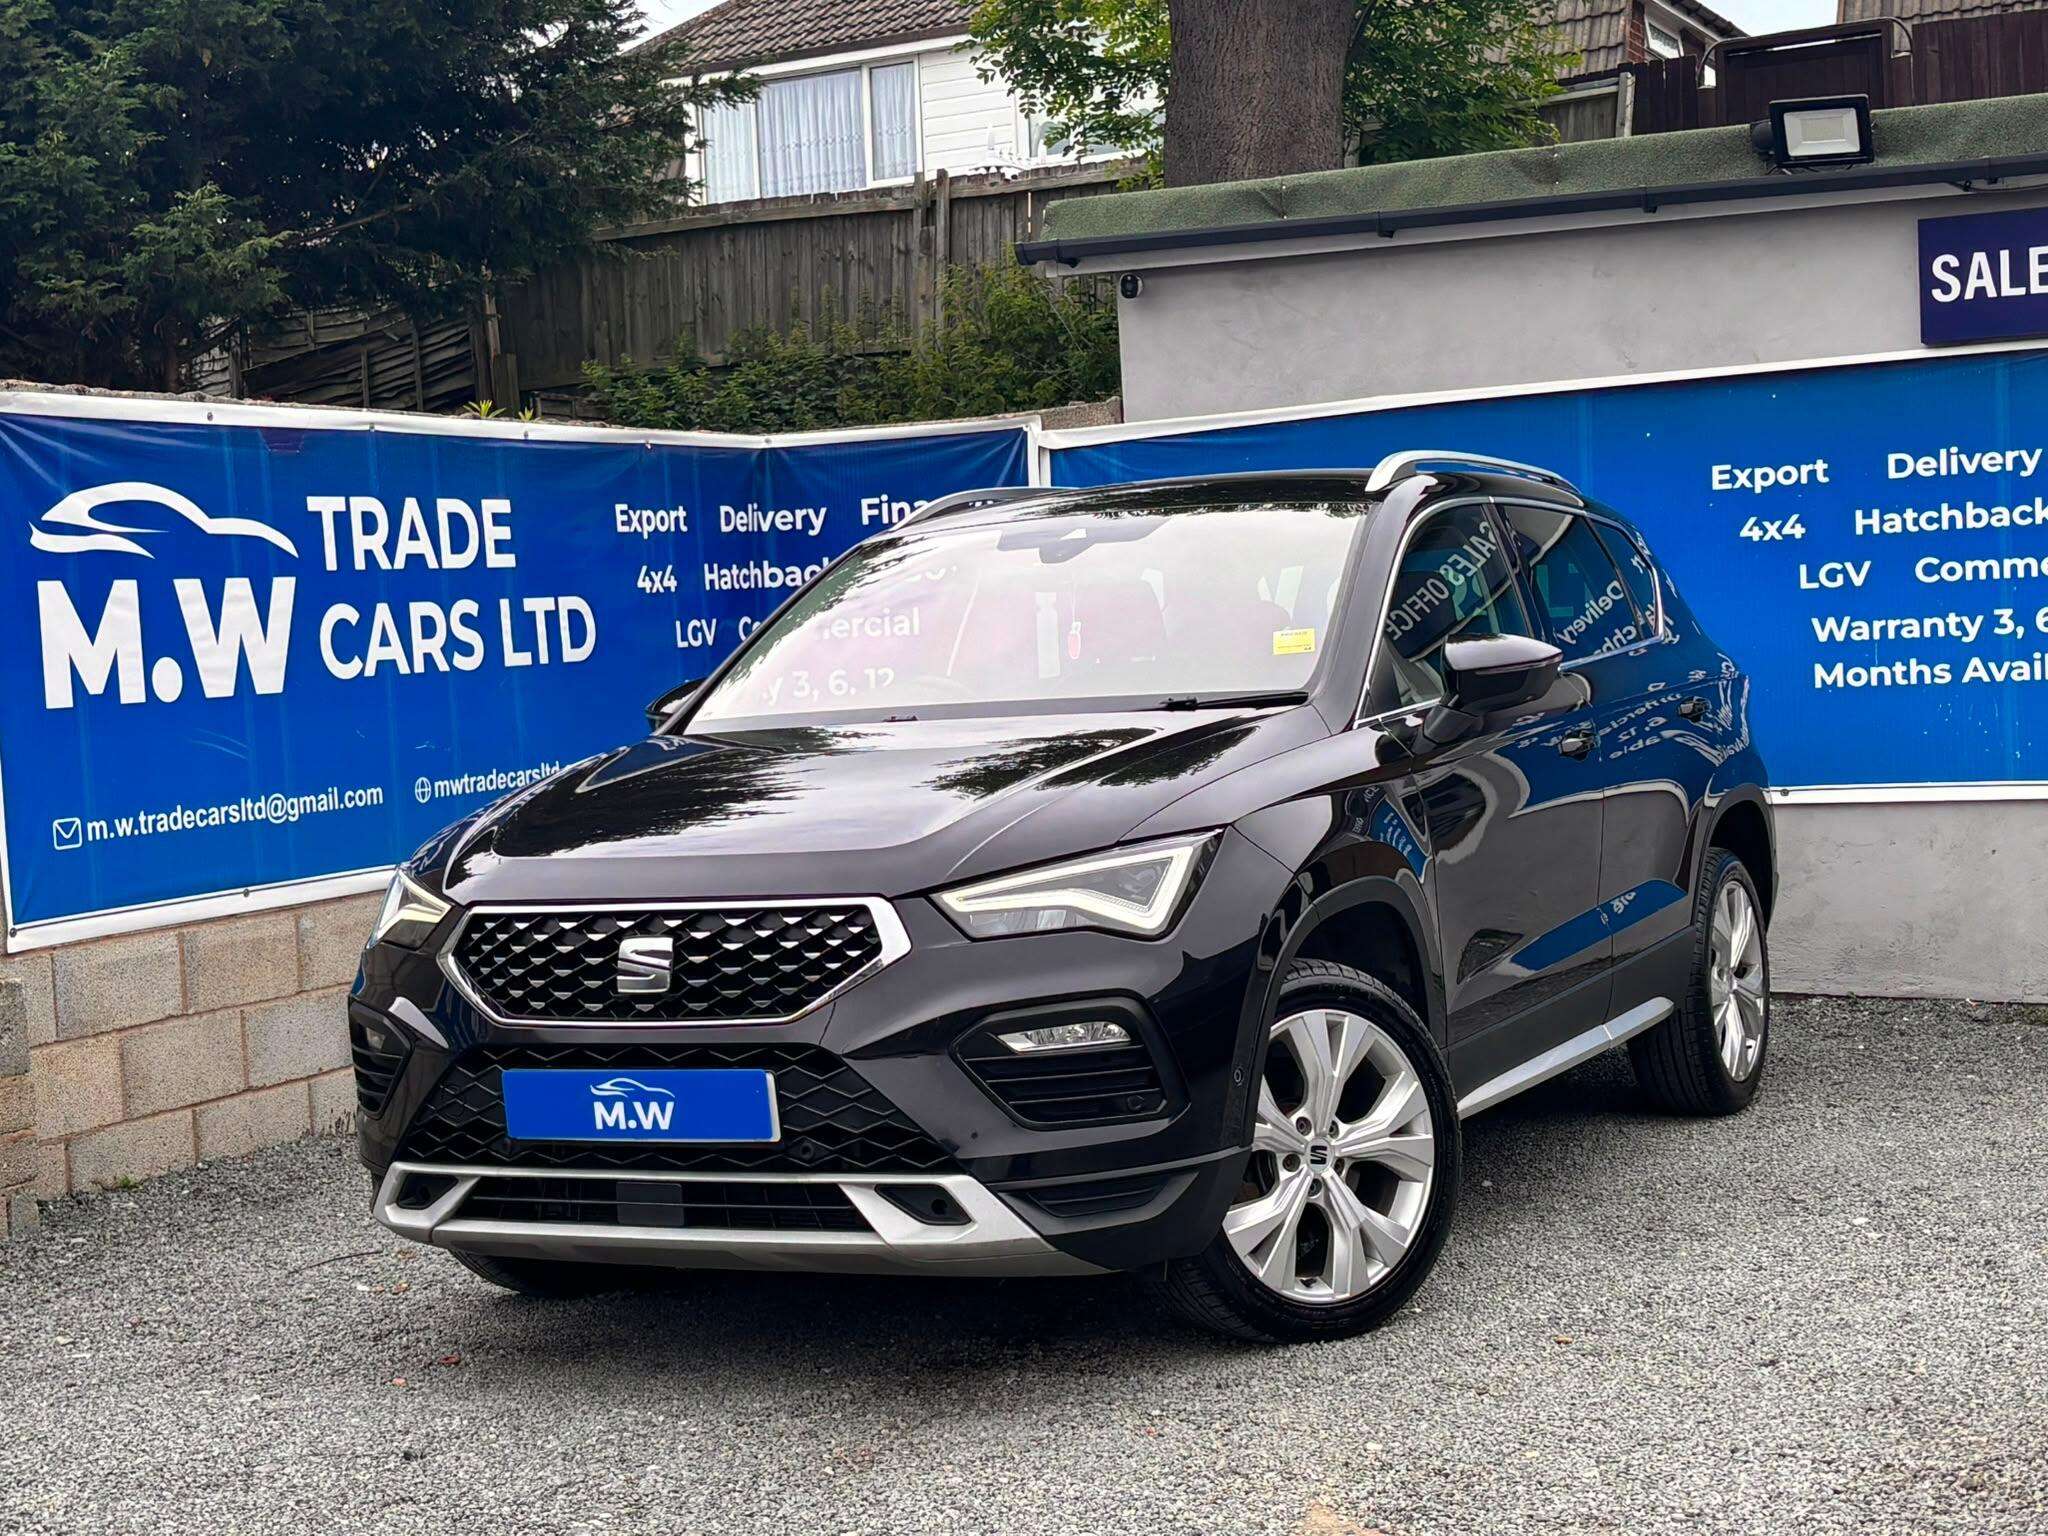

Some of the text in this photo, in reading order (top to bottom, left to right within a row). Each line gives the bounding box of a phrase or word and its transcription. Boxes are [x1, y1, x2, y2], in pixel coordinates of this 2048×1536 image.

[1931, 245, 2048, 303] SALE
[1711, 446, 2043, 494] Export Delivery
[306, 495, 517, 571] TRADE
[614, 503, 688, 539] Export
[719, 502, 828, 536] Delivery
[1739, 513, 1806, 542] 4x4
[636, 564, 678, 594] 4x4
[1799, 560, 1872, 590] LGV
[37, 576, 297, 710] M.W
[319, 595, 597, 680] CARS LTD
[675, 618, 718, 648] LGV
[1811, 612, 1984, 643] Warranty
[1993, 608, 2025, 640] 3,
[1814, 657, 1952, 689] Months
[434, 760, 560, 798] mwtradecarsltd
[86, 786, 384, 842] m.w.tradecarsltd@gmail.com
[593, 1101, 675, 1130] M.W
